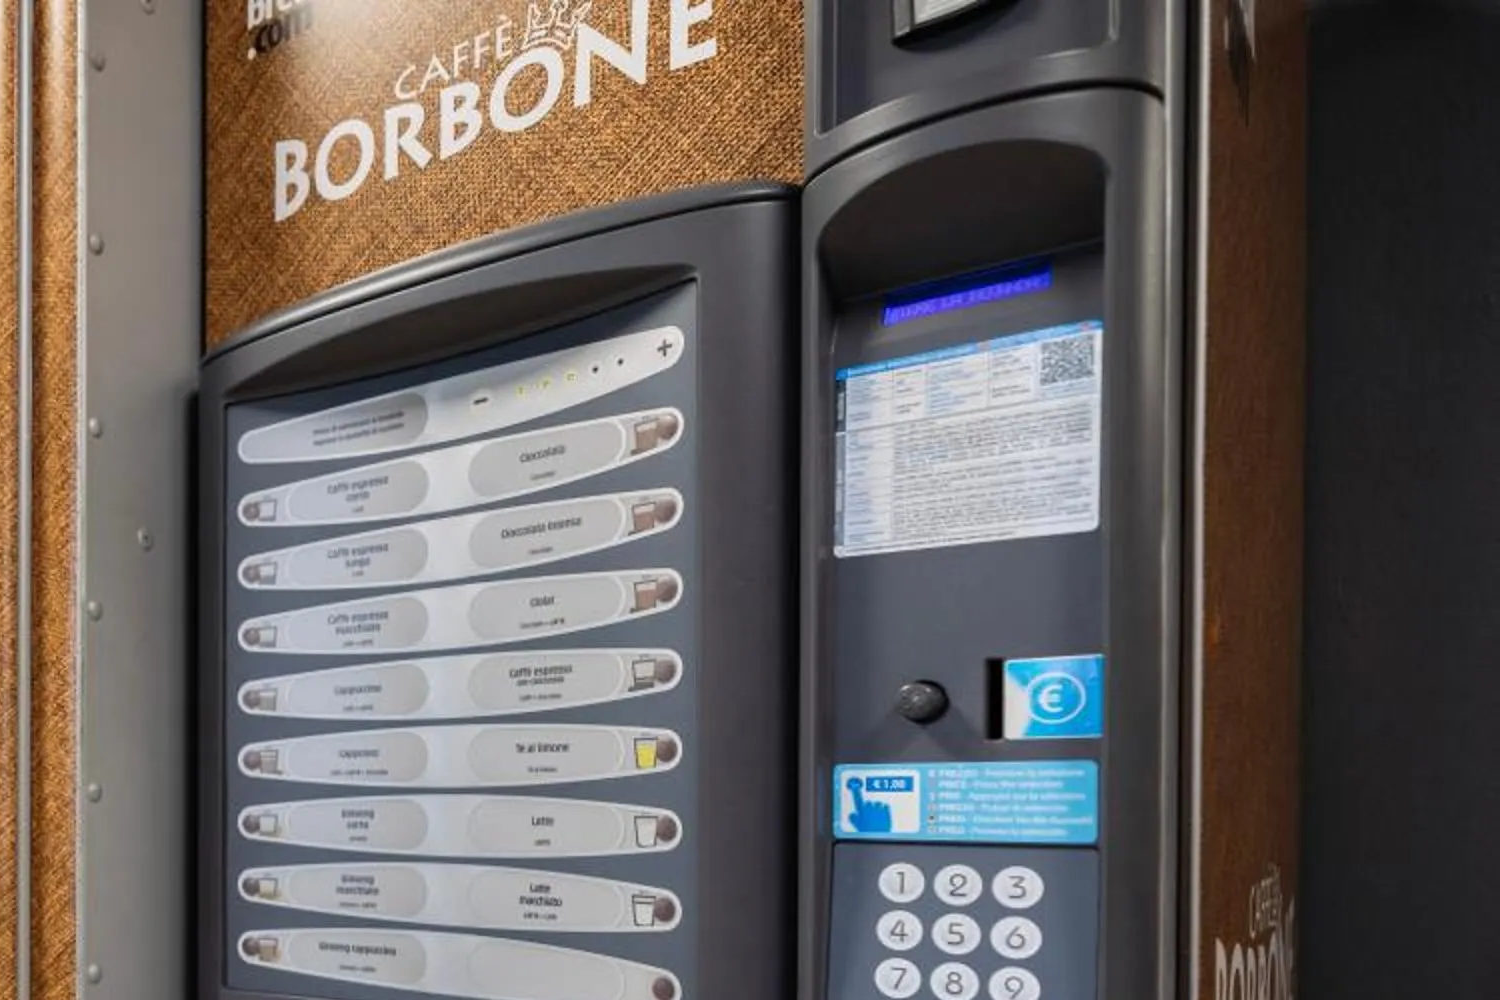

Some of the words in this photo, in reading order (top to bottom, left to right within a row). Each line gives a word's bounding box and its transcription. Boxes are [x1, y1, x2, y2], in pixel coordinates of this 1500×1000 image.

[395, 14, 513, 99] CAFFÈ
[275, 0, 717, 222] BORBONE
[538, 742, 570, 753] limone
[531, 816, 554, 827] Latte
[896, 871, 906, 895] 1
[949, 872, 968, 897] 2
[1008, 875, 1027, 899] 3
[890, 919, 908, 943] 4
[947, 922, 965, 946] 5
[1005, 926, 1026, 950] 6
[890, 967, 907, 991] 7
[945, 971, 964, 995] 8
[1003, 976, 1024, 1000] 9
